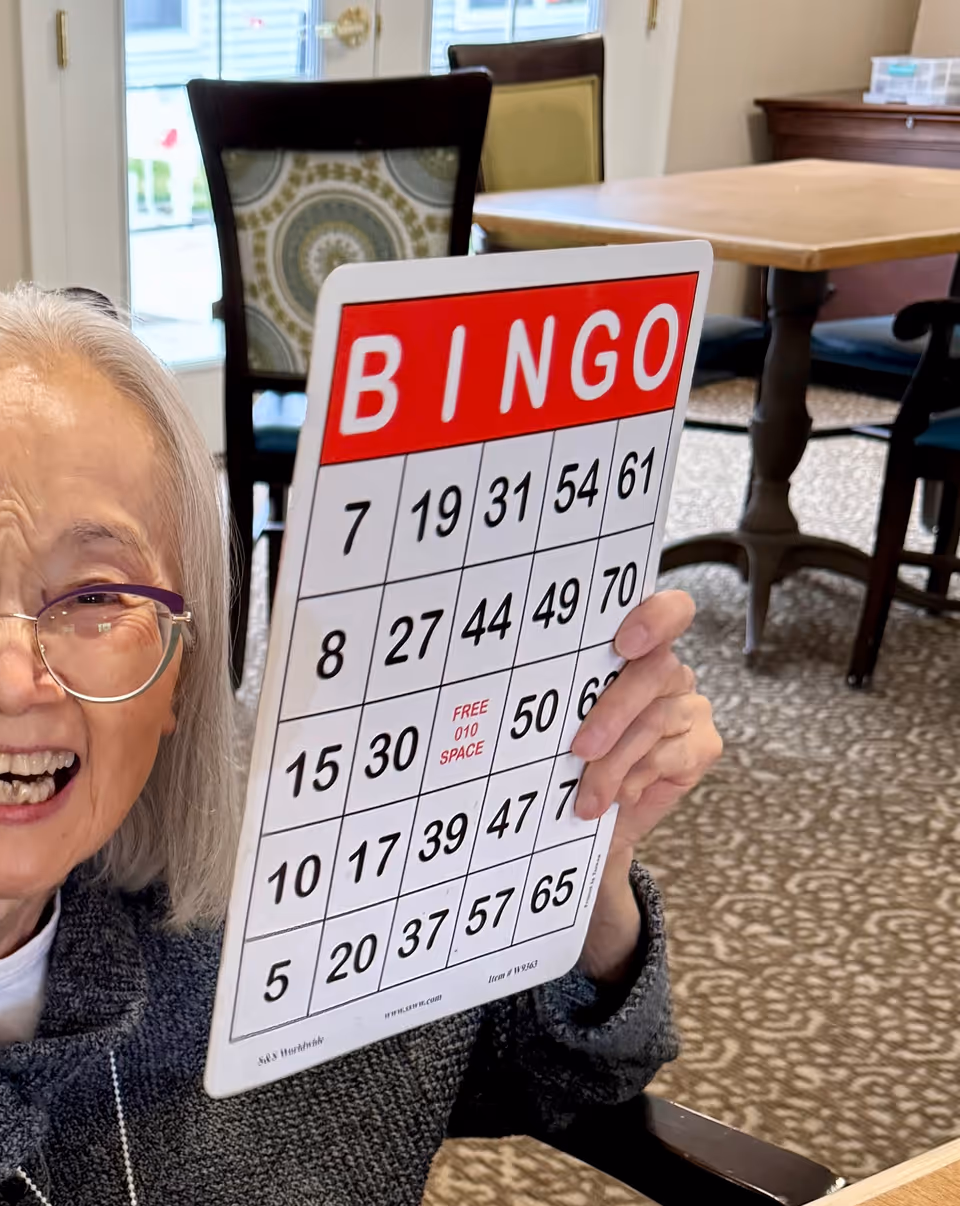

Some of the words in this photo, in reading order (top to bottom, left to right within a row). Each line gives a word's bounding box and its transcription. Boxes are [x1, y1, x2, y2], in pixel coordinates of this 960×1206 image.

[340, 303, 678, 435] BINGO
[344, 501, 371, 555] 7
[412, 485, 461, 542] 19
[484, 471, 531, 528] 31
[554, 458, 599, 513] 54
[618, 447, 655, 499] 61
[317, 630, 346, 679] 8
[385, 609, 444, 666] 27
[461, 592, 512, 646] 44
[532, 578, 579, 629] 49
[601, 562, 637, 613] 70
[286, 744, 342, 797] 15
[365, 726, 418, 779] 30
[511, 689, 558, 739] 50
[440, 741, 484, 765] SPACE
[452, 699, 489, 721] FREE
[454, 722, 478, 741] 010
[268, 855, 321, 904] 10
[349, 832, 401, 883] 17
[419, 813, 468, 862] 39
[487, 791, 538, 839] 47
[264, 960, 291, 1002] 5
[326, 934, 377, 984] 20
[398, 909, 449, 958] 37
[466, 887, 515, 935] 57
[531, 867, 577, 913] 65
[488, 971, 506, 984] Item
[513, 959, 538, 976] W9363
